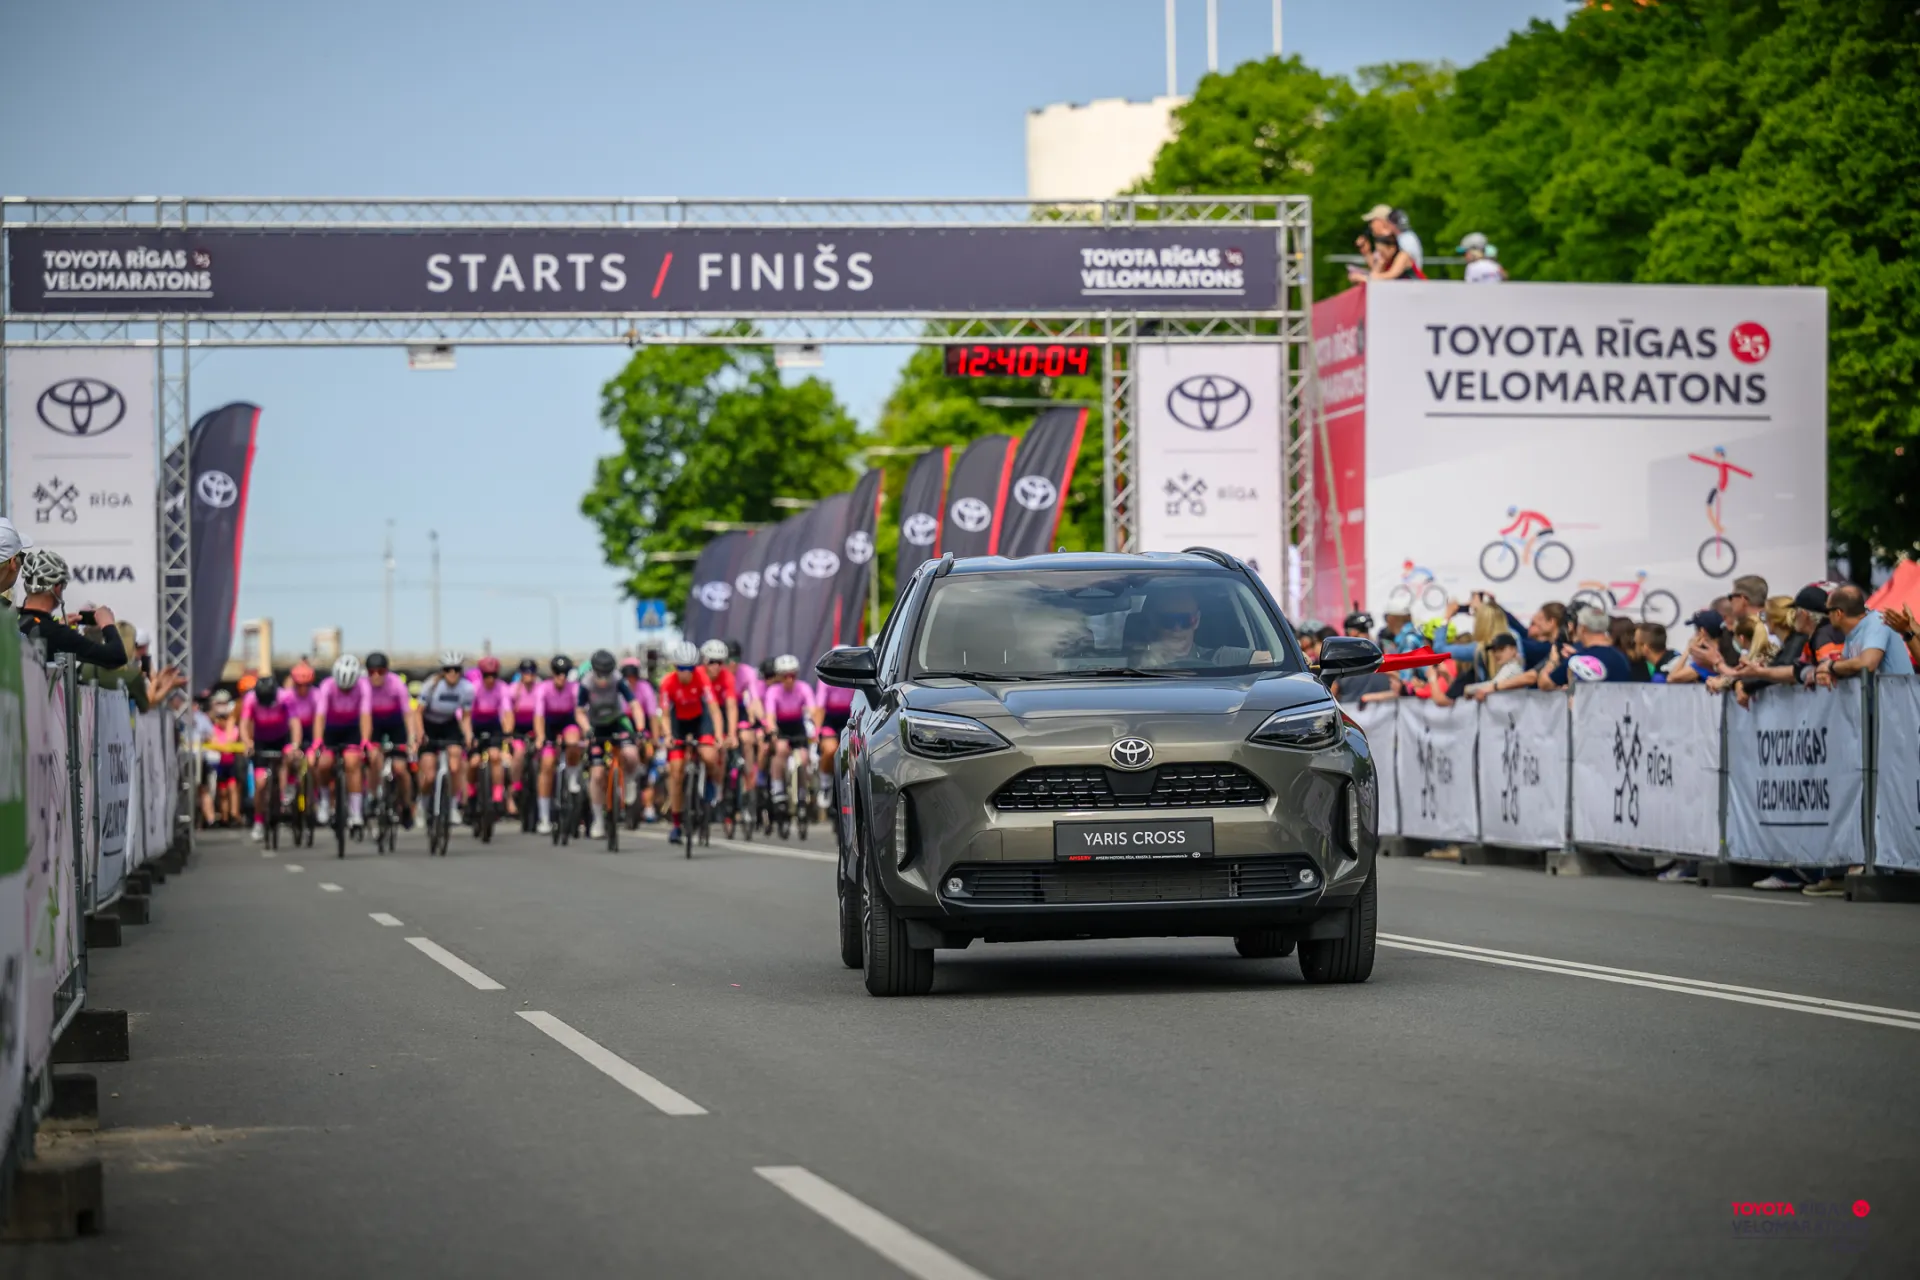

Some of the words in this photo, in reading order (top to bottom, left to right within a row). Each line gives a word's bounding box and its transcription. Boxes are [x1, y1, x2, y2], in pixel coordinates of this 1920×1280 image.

[43, 249, 122, 270] TOYOTA
[125, 245, 188, 270] RĪGAS
[426, 253, 627, 292] STARTS
[699, 243, 874, 292] FINIŠS
[1080, 248, 1159, 268] TOYOTA
[1160, 244, 1221, 268] RĪGAS
[43, 270, 212, 291] VELOMARATONS
[1080, 268, 1245, 289] VELOMARATONS
[1425, 325, 1583, 357] TOYOTA
[1596, 318, 1718, 359] RĪGAS
[958, 344, 1089, 377] 12:40:04
[1425, 370, 1767, 405] VELOMARATONS
[90, 490, 133, 508] RĪGA
[68, 564, 135, 584] XIMA
[1757, 729, 1794, 767] TOYOTA
[1646, 746, 1673, 787] RĪGA
[1757, 778, 1830, 811] VELOMARATONS
[1084, 832, 1128, 846] YARIS
[1132, 830, 1186, 845] CROSS
